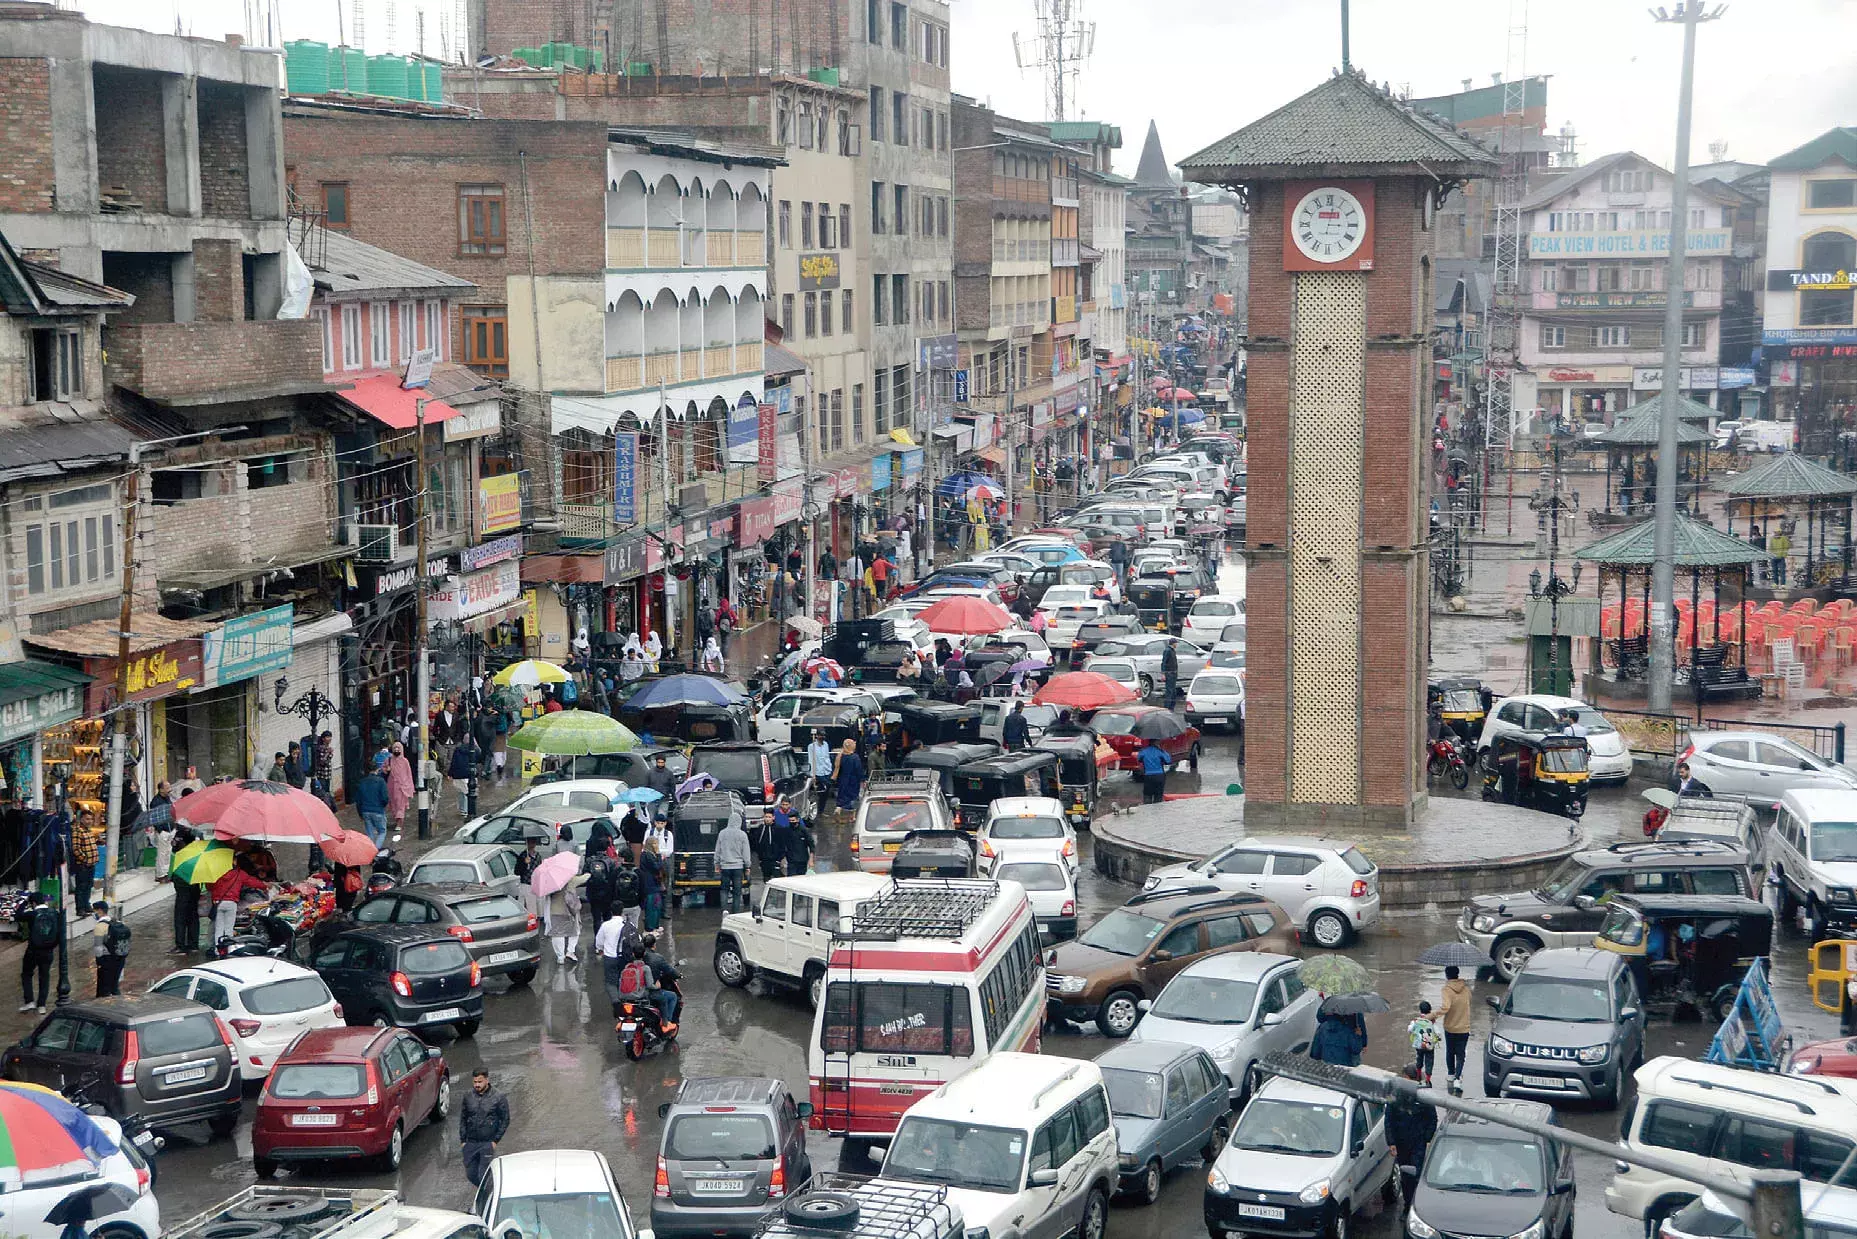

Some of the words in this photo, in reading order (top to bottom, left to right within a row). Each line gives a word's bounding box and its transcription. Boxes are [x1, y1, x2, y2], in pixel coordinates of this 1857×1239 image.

[1532, 236, 1561, 253] PEAK
[1564, 236, 1594, 252] VIEW
[1598, 235, 1634, 252] HOTEL
[1638, 235, 1646, 252] &
[1651, 233, 1729, 251] RESURANT
[1573, 295, 1599, 306] PEAK
[1608, 295, 1633, 306] VIEW
[1765, 329, 1817, 338] KHURSHID
[1820, 329, 1835, 338] BIN
[1838, 329, 1857, 337] ALI
[755, 511, 771, 529] TITAN
[610, 551, 617, 574] U
[619, 548, 625, 570] &
[627, 546, 631, 568] I
[378, 566, 416, 594] BOMBAY
[426, 556, 449, 577] TORE
[468, 570, 500, 604] EXIDE
[39, 687, 75, 717] SALE
[724, 1181, 741, 1190] 5924
